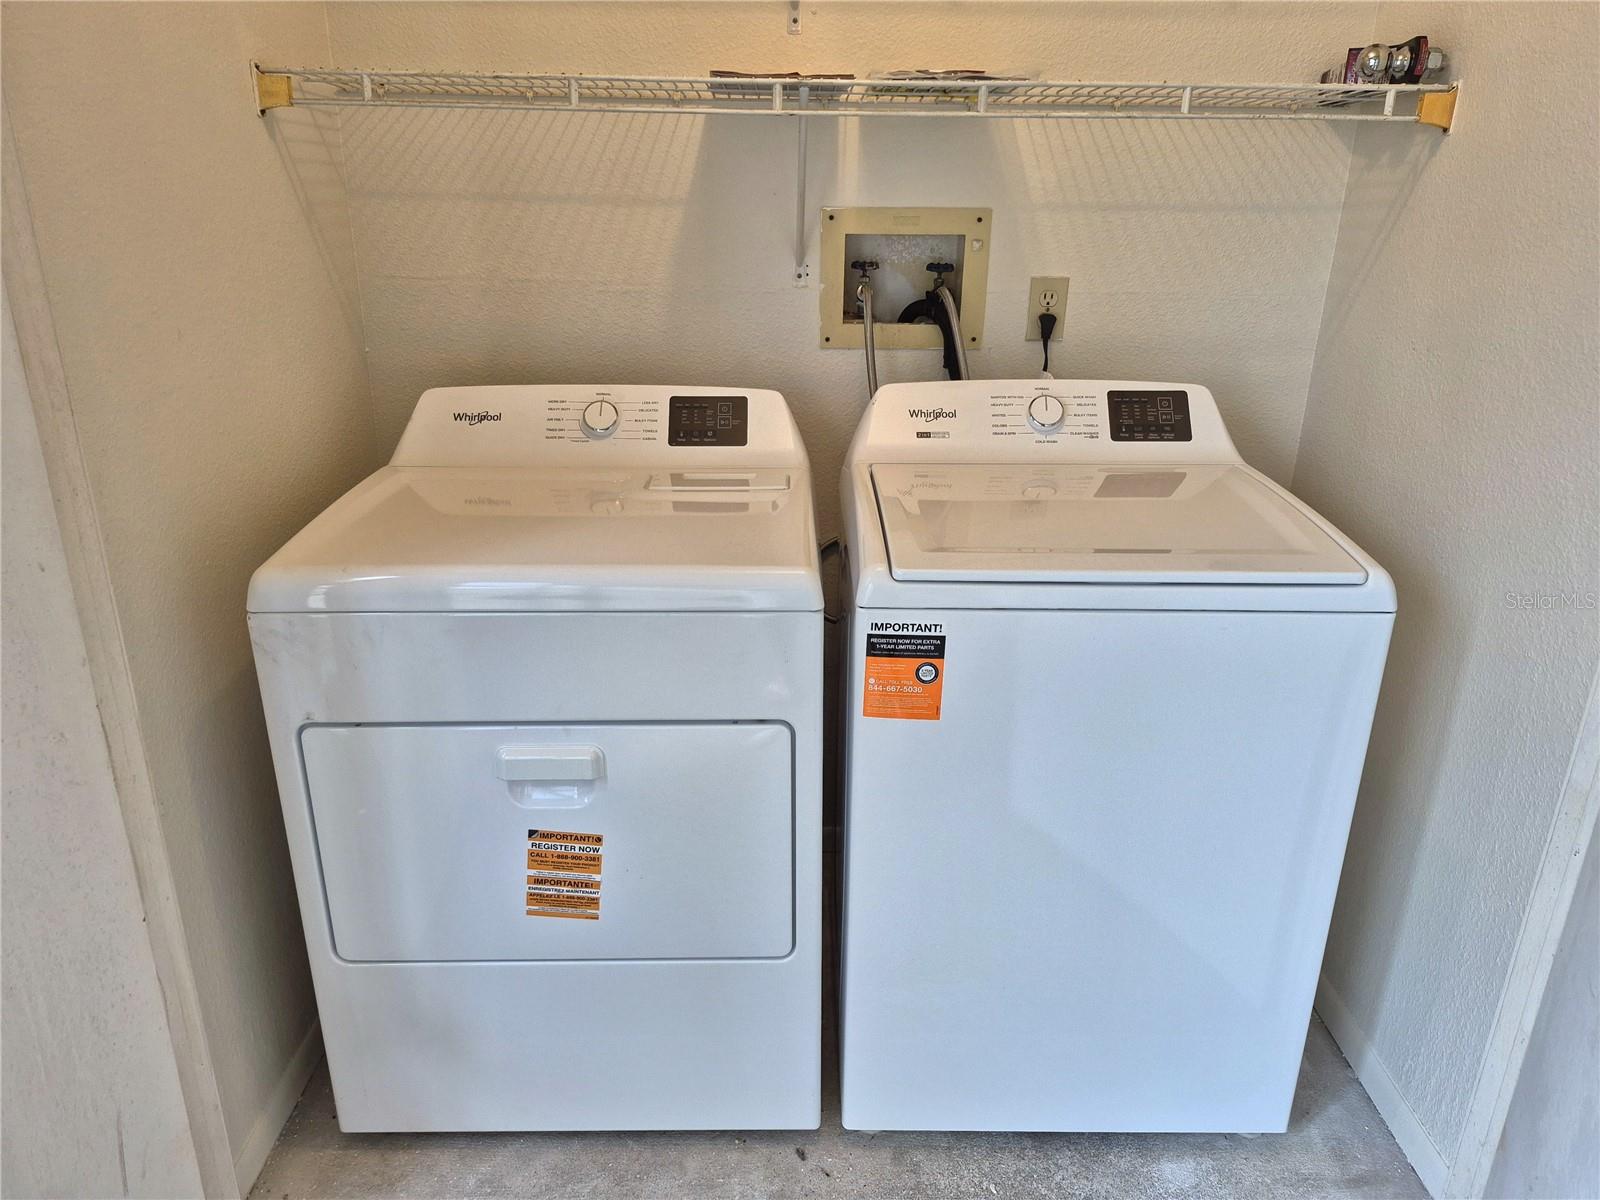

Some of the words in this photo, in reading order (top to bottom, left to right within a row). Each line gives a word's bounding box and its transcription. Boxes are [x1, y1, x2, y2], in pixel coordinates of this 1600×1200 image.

[453, 410, 502, 426] Whirlpool
[908, 407, 957, 423] Whirlpool
[870, 622, 943, 633] IMPORTANT!
[867, 684, 923, 693] 844-667-5030
[539, 832, 594, 843] IMPORTANT!
[531, 842, 576, 852] REGISTER
[578, 846, 601, 854] NOW
[533, 877, 594, 889] IMPORTANTE!
[528, 886, 565, 894] ENREGISTREZ
